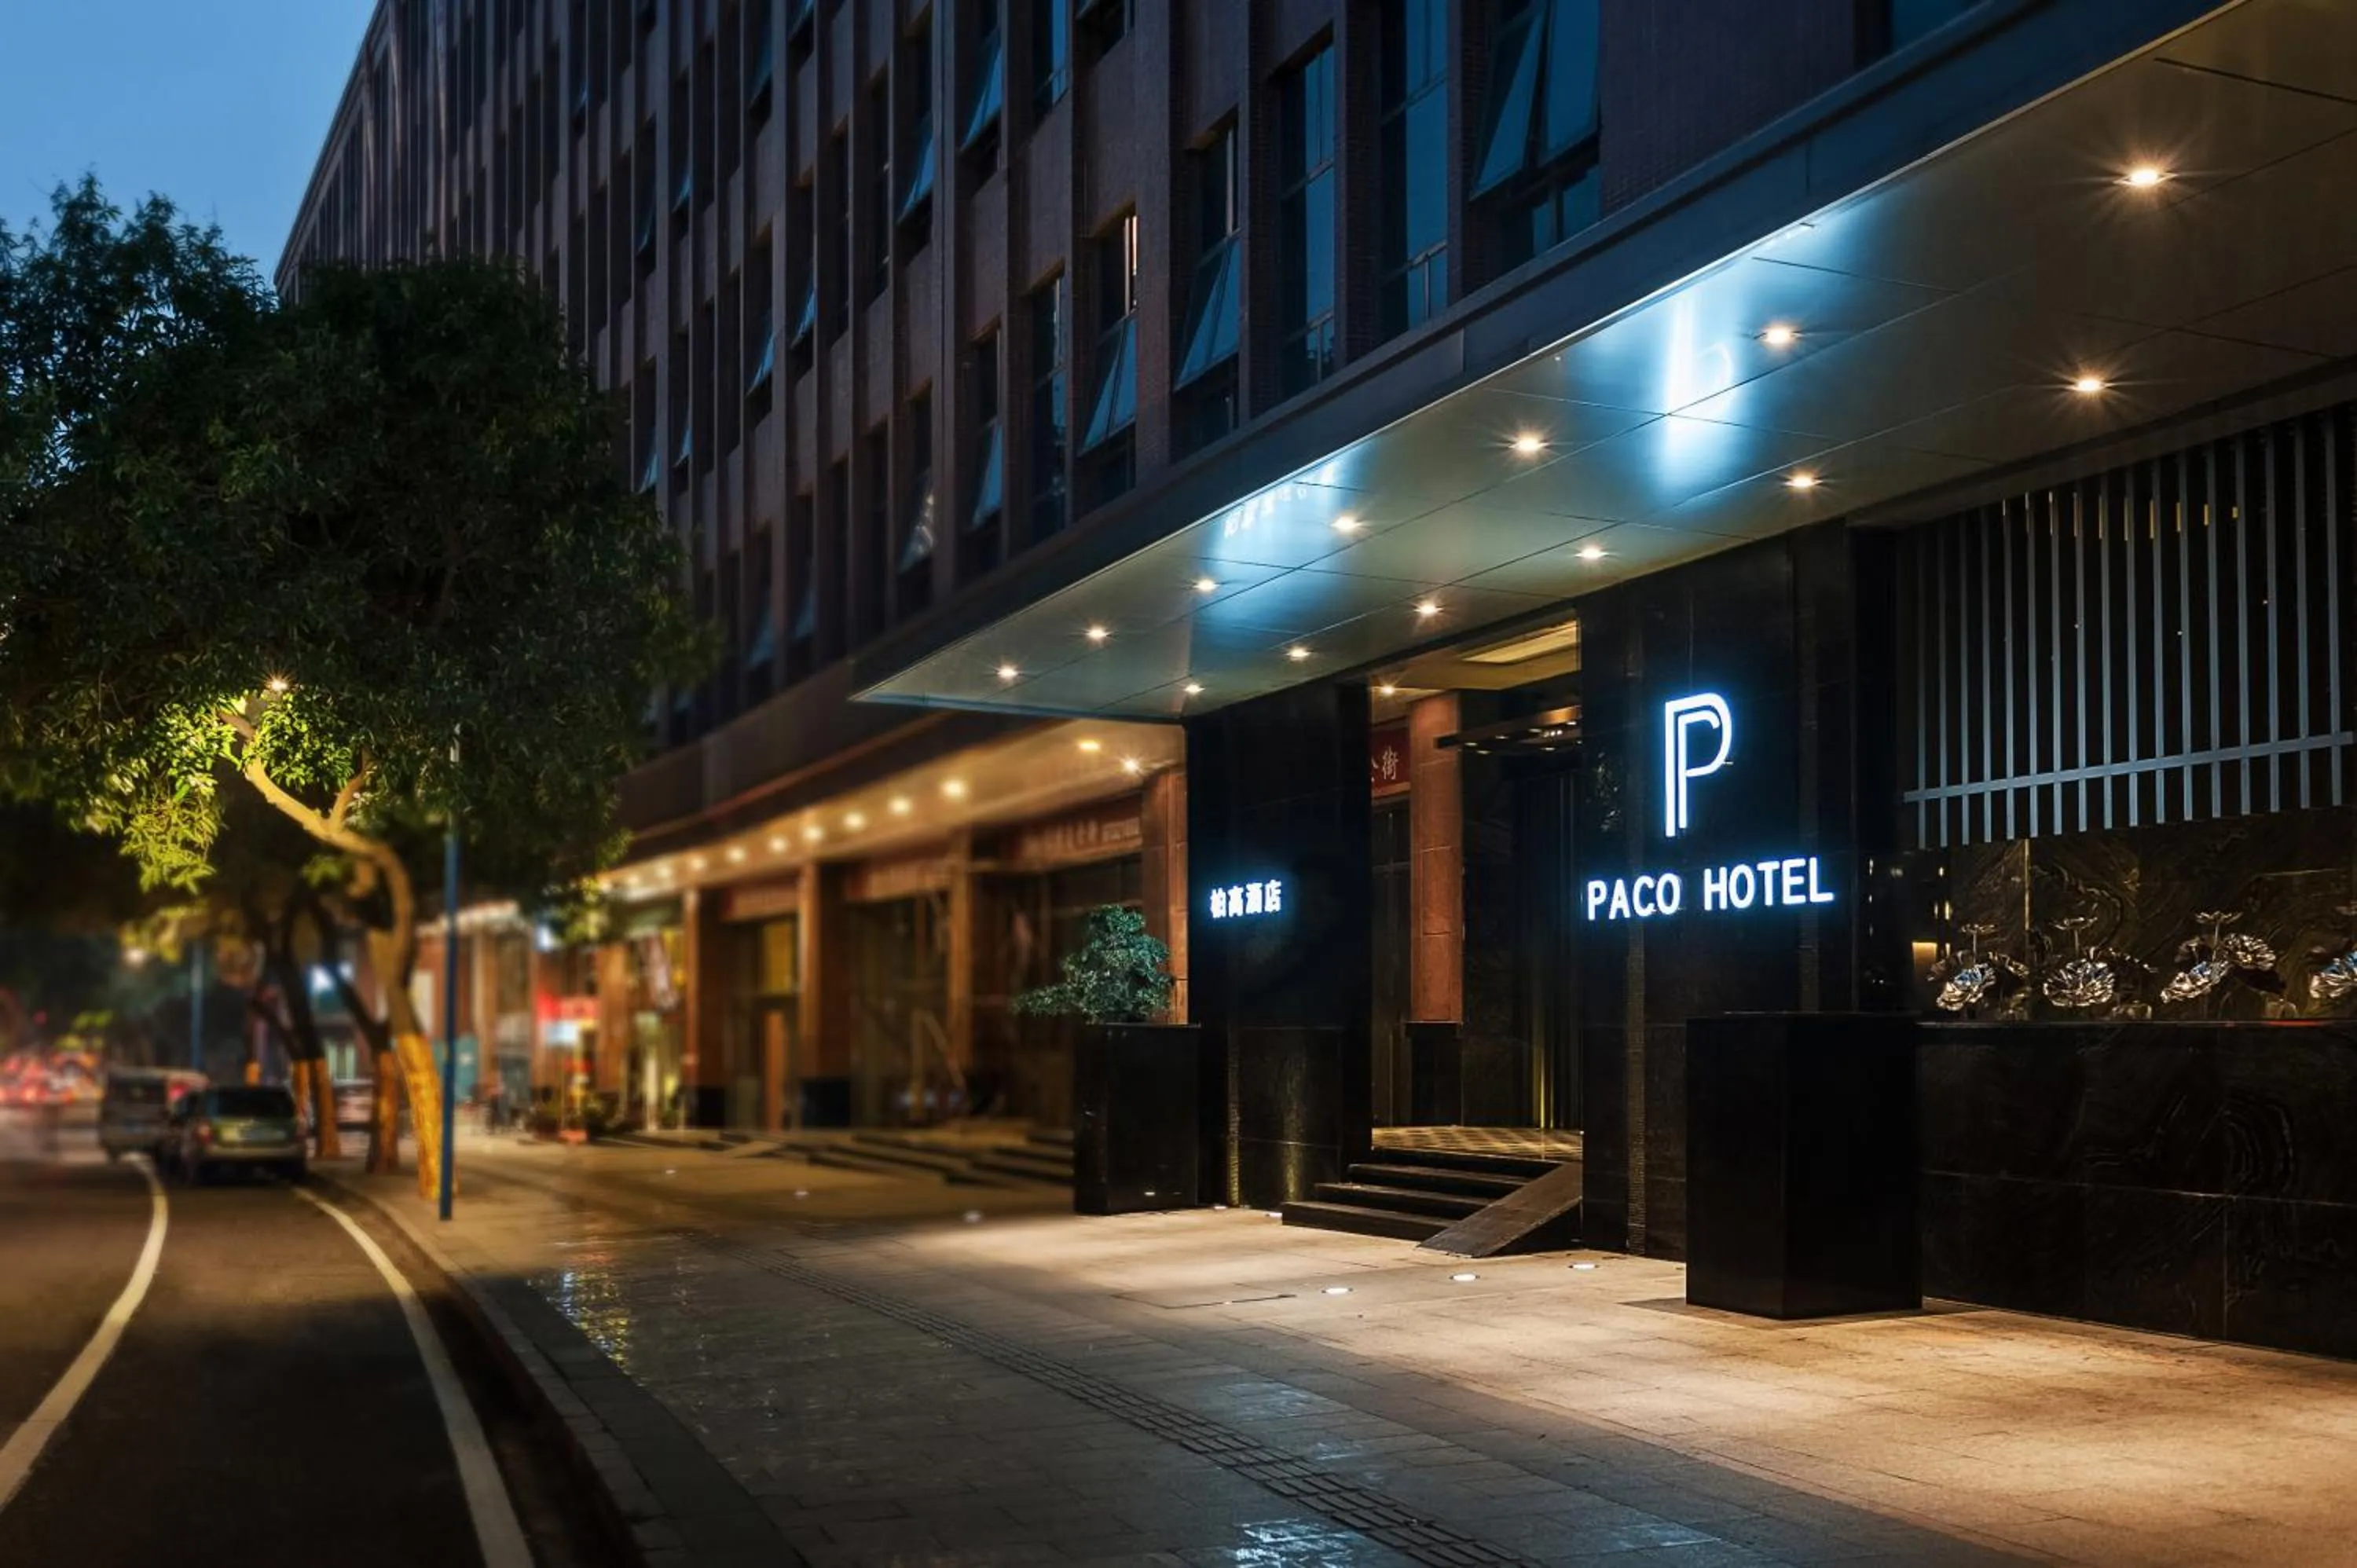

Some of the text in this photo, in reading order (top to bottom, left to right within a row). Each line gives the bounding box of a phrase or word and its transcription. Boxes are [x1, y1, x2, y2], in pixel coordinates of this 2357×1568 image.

[1664, 692, 1733, 837] P
[1587, 856, 1835, 921] PACO HOTEL
